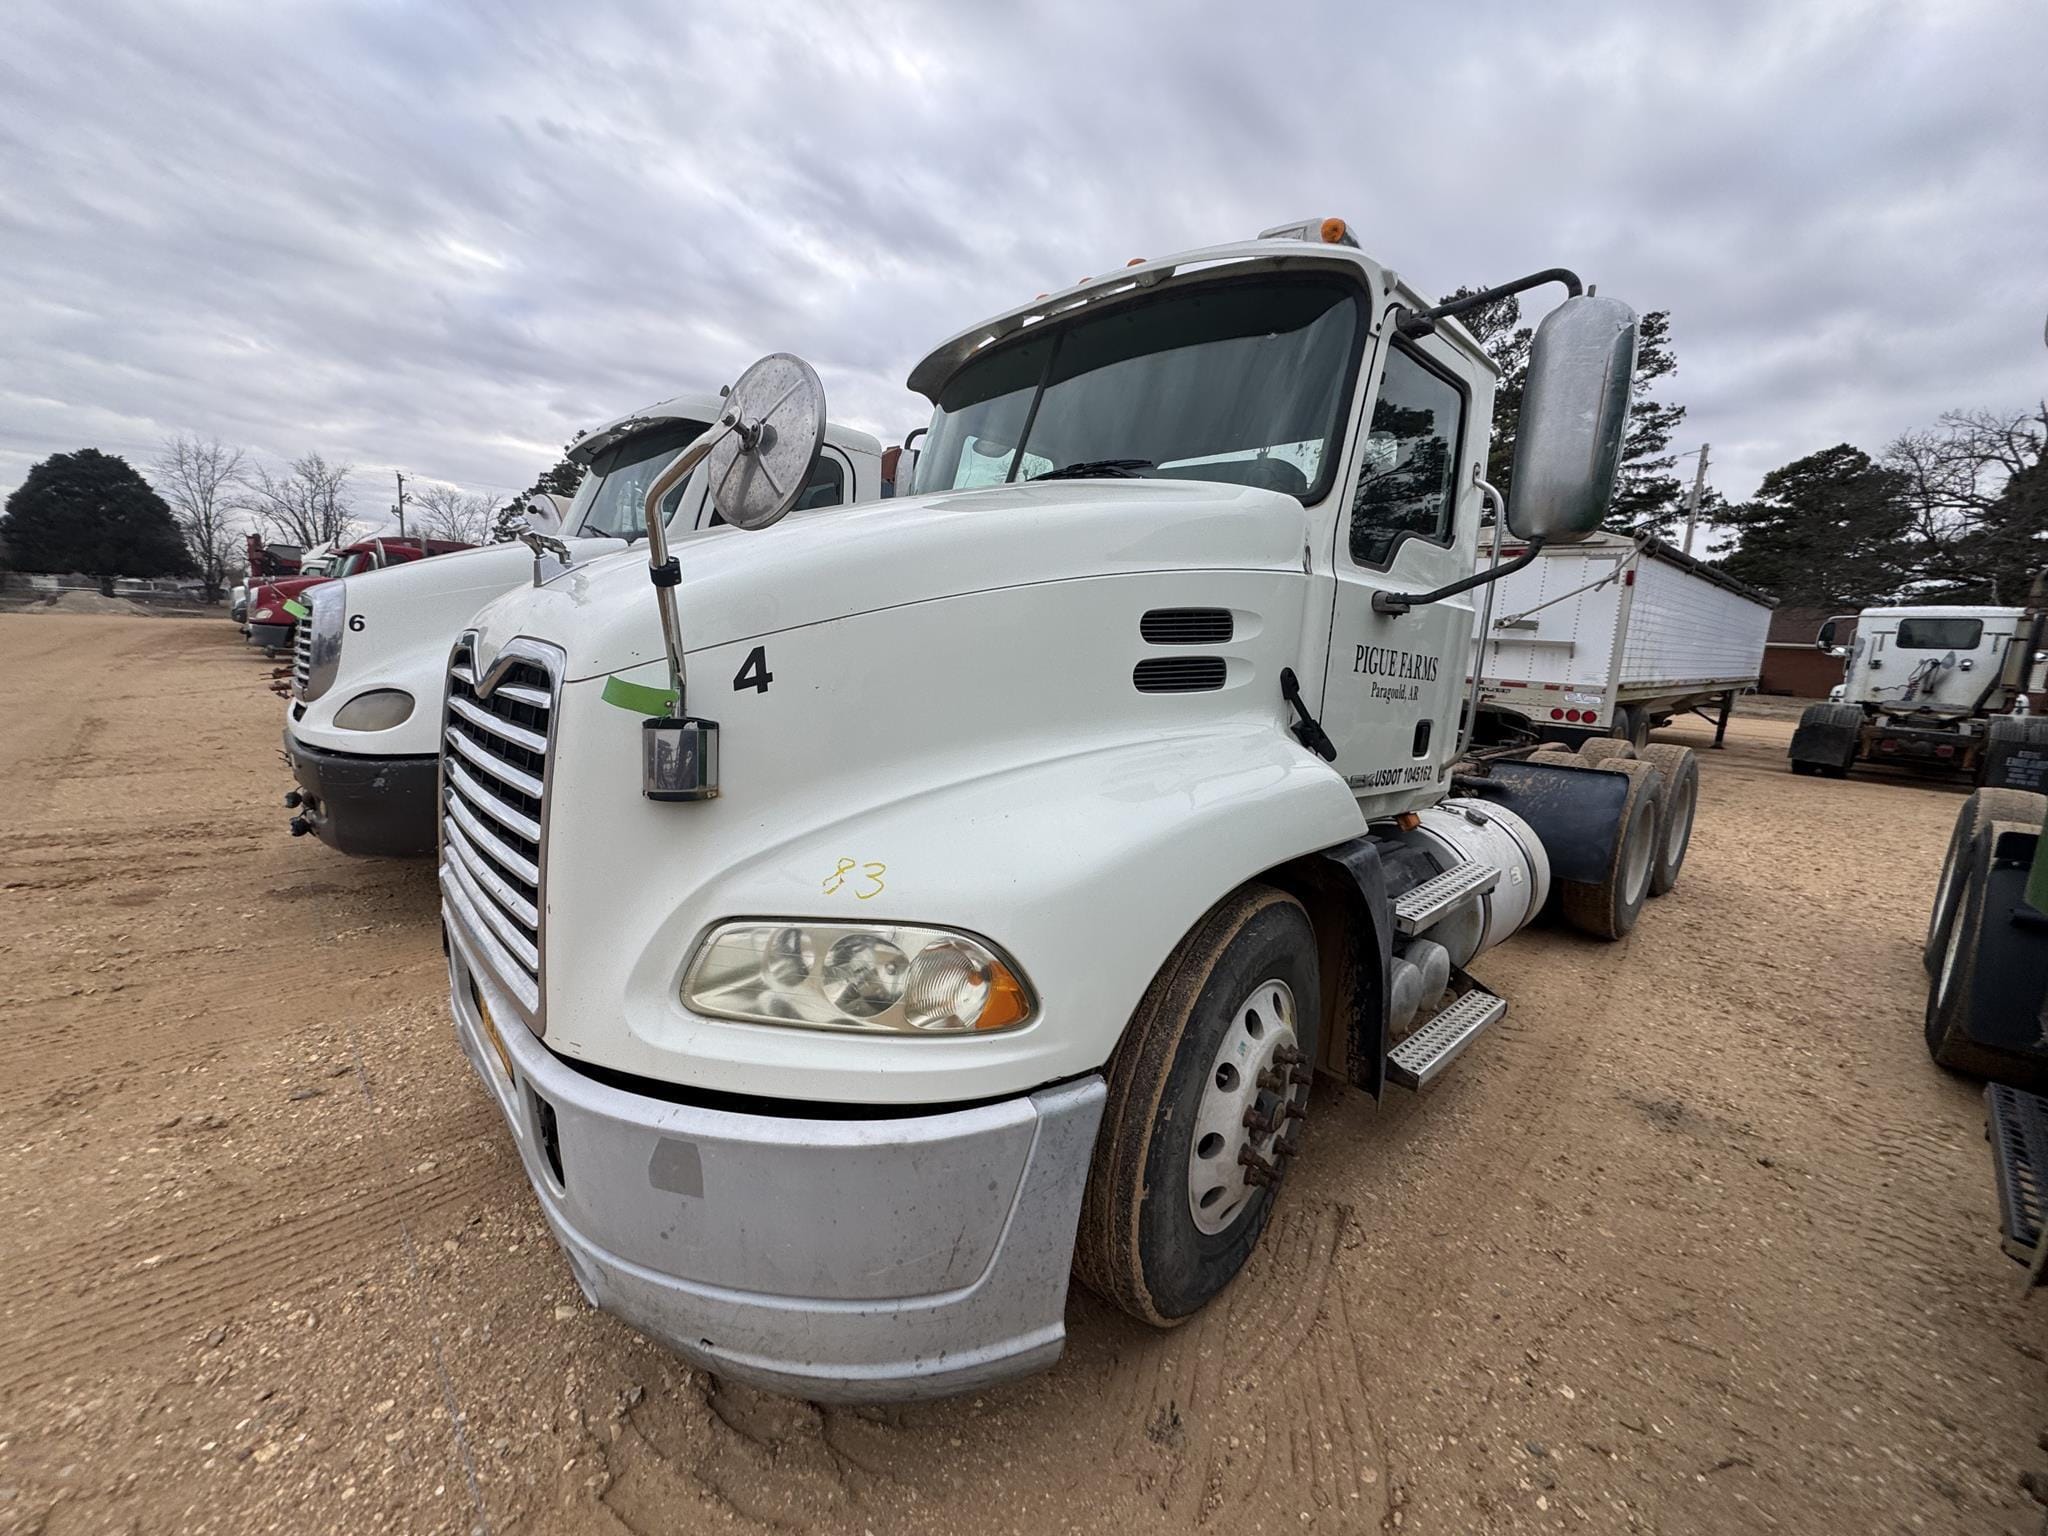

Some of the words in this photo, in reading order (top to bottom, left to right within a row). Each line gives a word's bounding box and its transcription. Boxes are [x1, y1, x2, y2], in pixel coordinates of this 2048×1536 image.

[349, 614, 365, 632] 6
[733, 646, 773, 694] 4
[1353, 644, 1398, 677] PIGUE
[1398, 651, 1439, 682] FARMS
[1371, 681, 1407, 705] Paragould,
[1407, 685, 1419, 701] AR
[1374, 768, 1403, 787] USDOT
[1403, 765, 1432, 784] 1045162
[822, 857, 886, 899] 83
